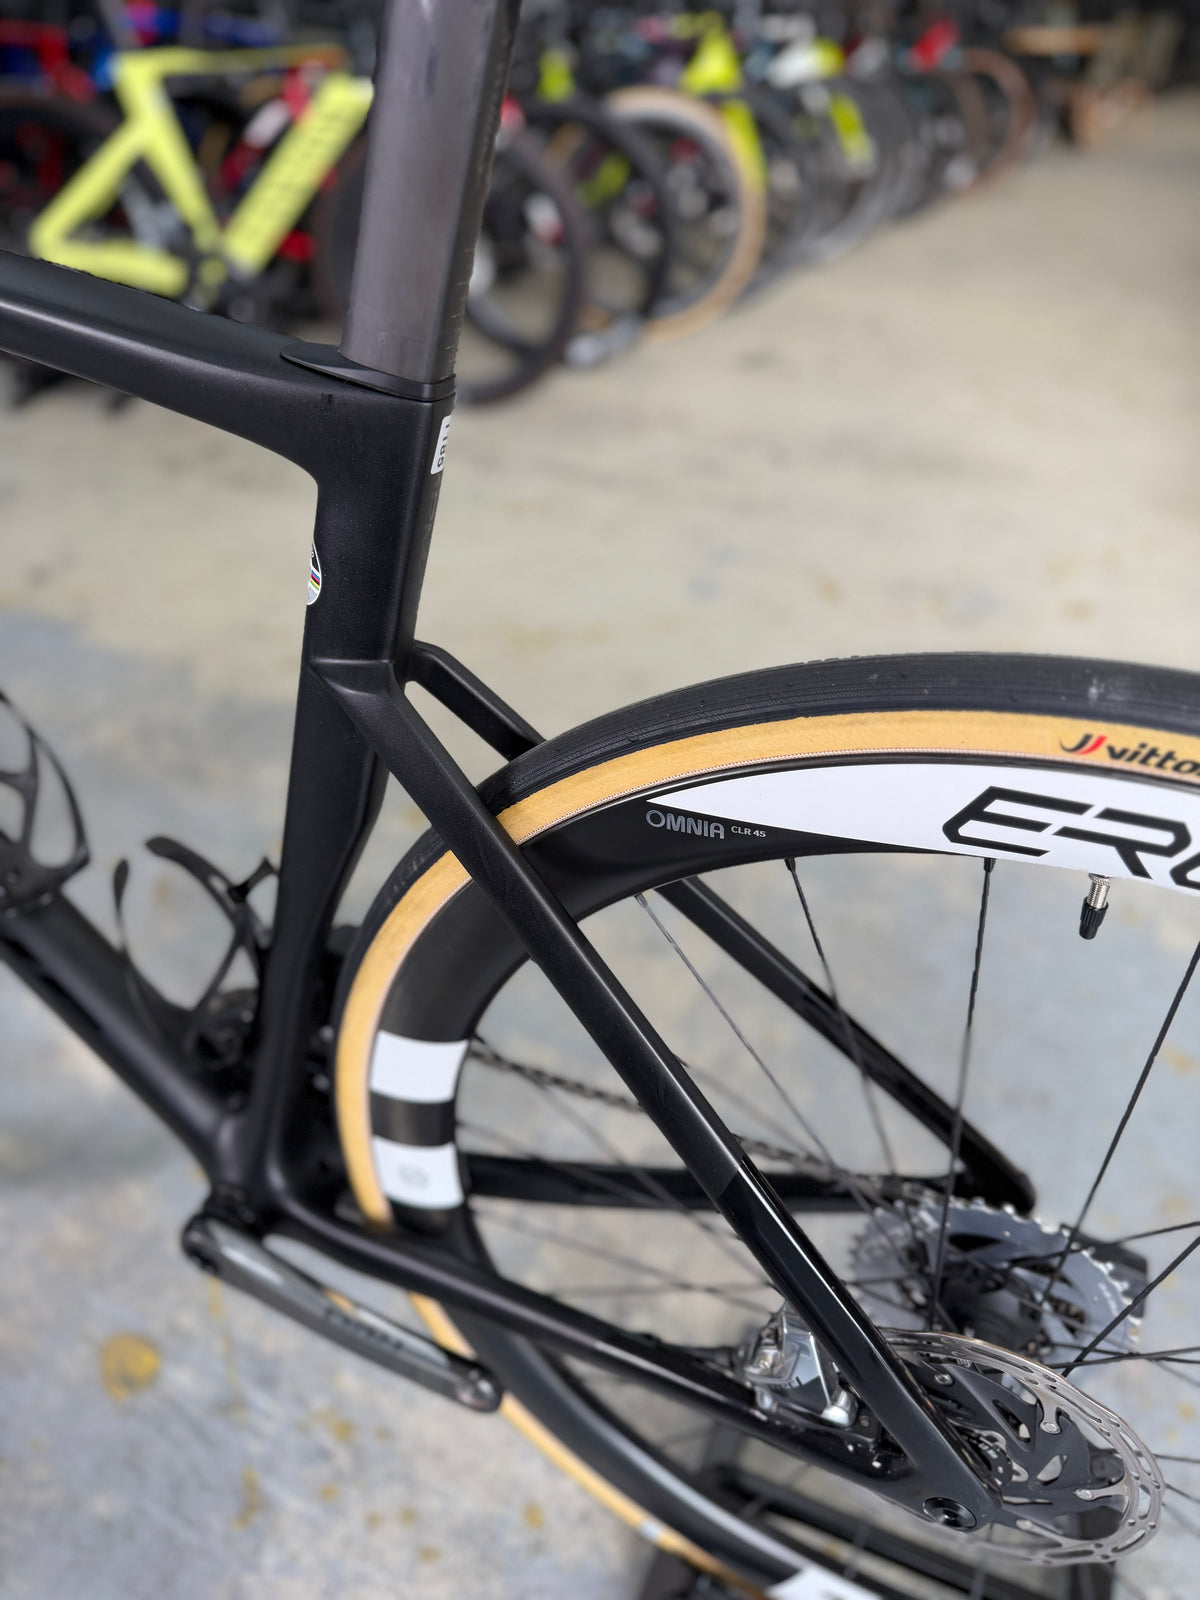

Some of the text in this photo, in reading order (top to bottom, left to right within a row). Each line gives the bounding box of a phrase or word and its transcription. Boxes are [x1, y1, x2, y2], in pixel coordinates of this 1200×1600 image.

[1106, 742, 1200, 776] vitto
[645, 809, 767, 840] OMNIA CLR 45
[942, 785, 1200, 890] ER
